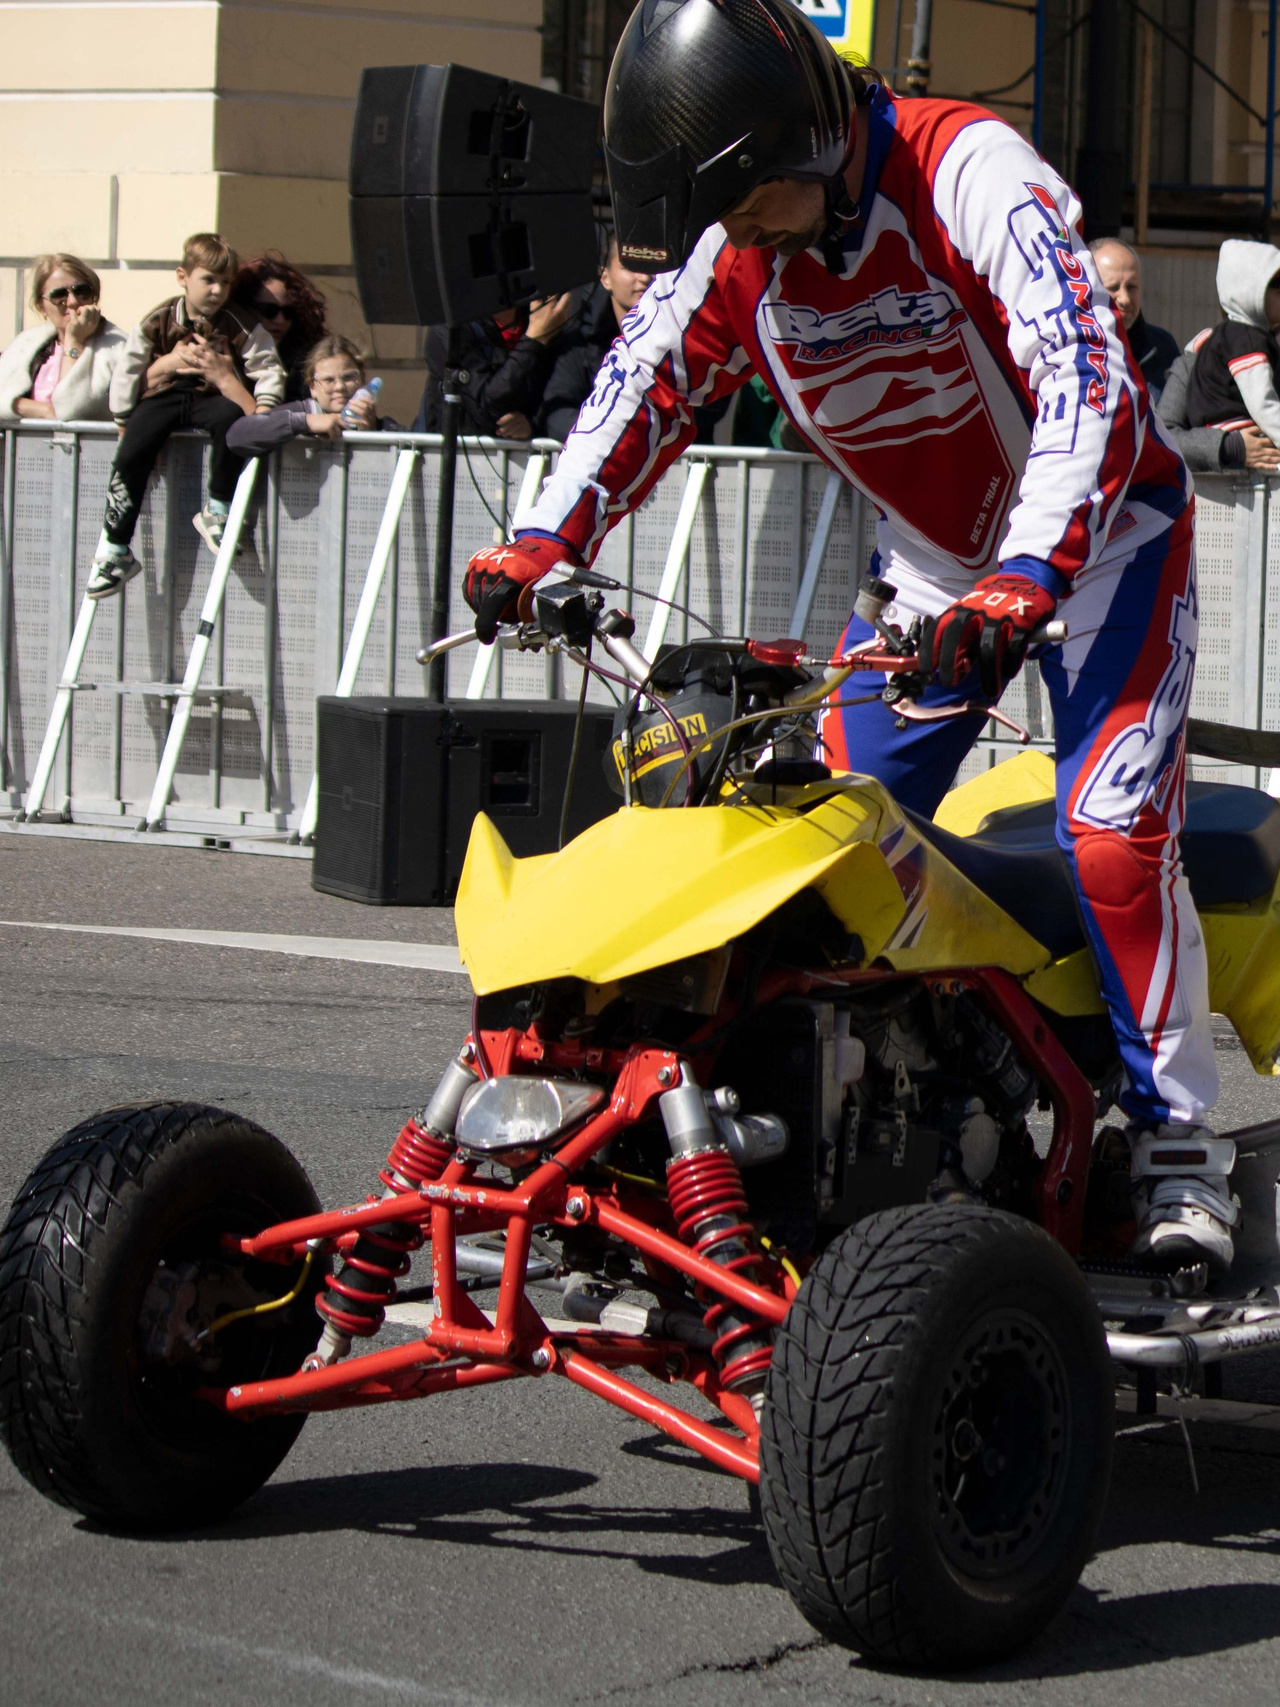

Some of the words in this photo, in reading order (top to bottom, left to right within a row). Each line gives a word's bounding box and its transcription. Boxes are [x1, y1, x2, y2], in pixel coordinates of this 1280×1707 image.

[762, 287, 957, 343] Beta
[801, 326, 922, 359] RACING
[1055, 247, 1105, 414] RACING
[970, 512, 988, 544] BETA
[982, 476, 1001, 509] TRIAL
[1076, 515, 1198, 832] Bet
[611, 716, 705, 774] PCISION
